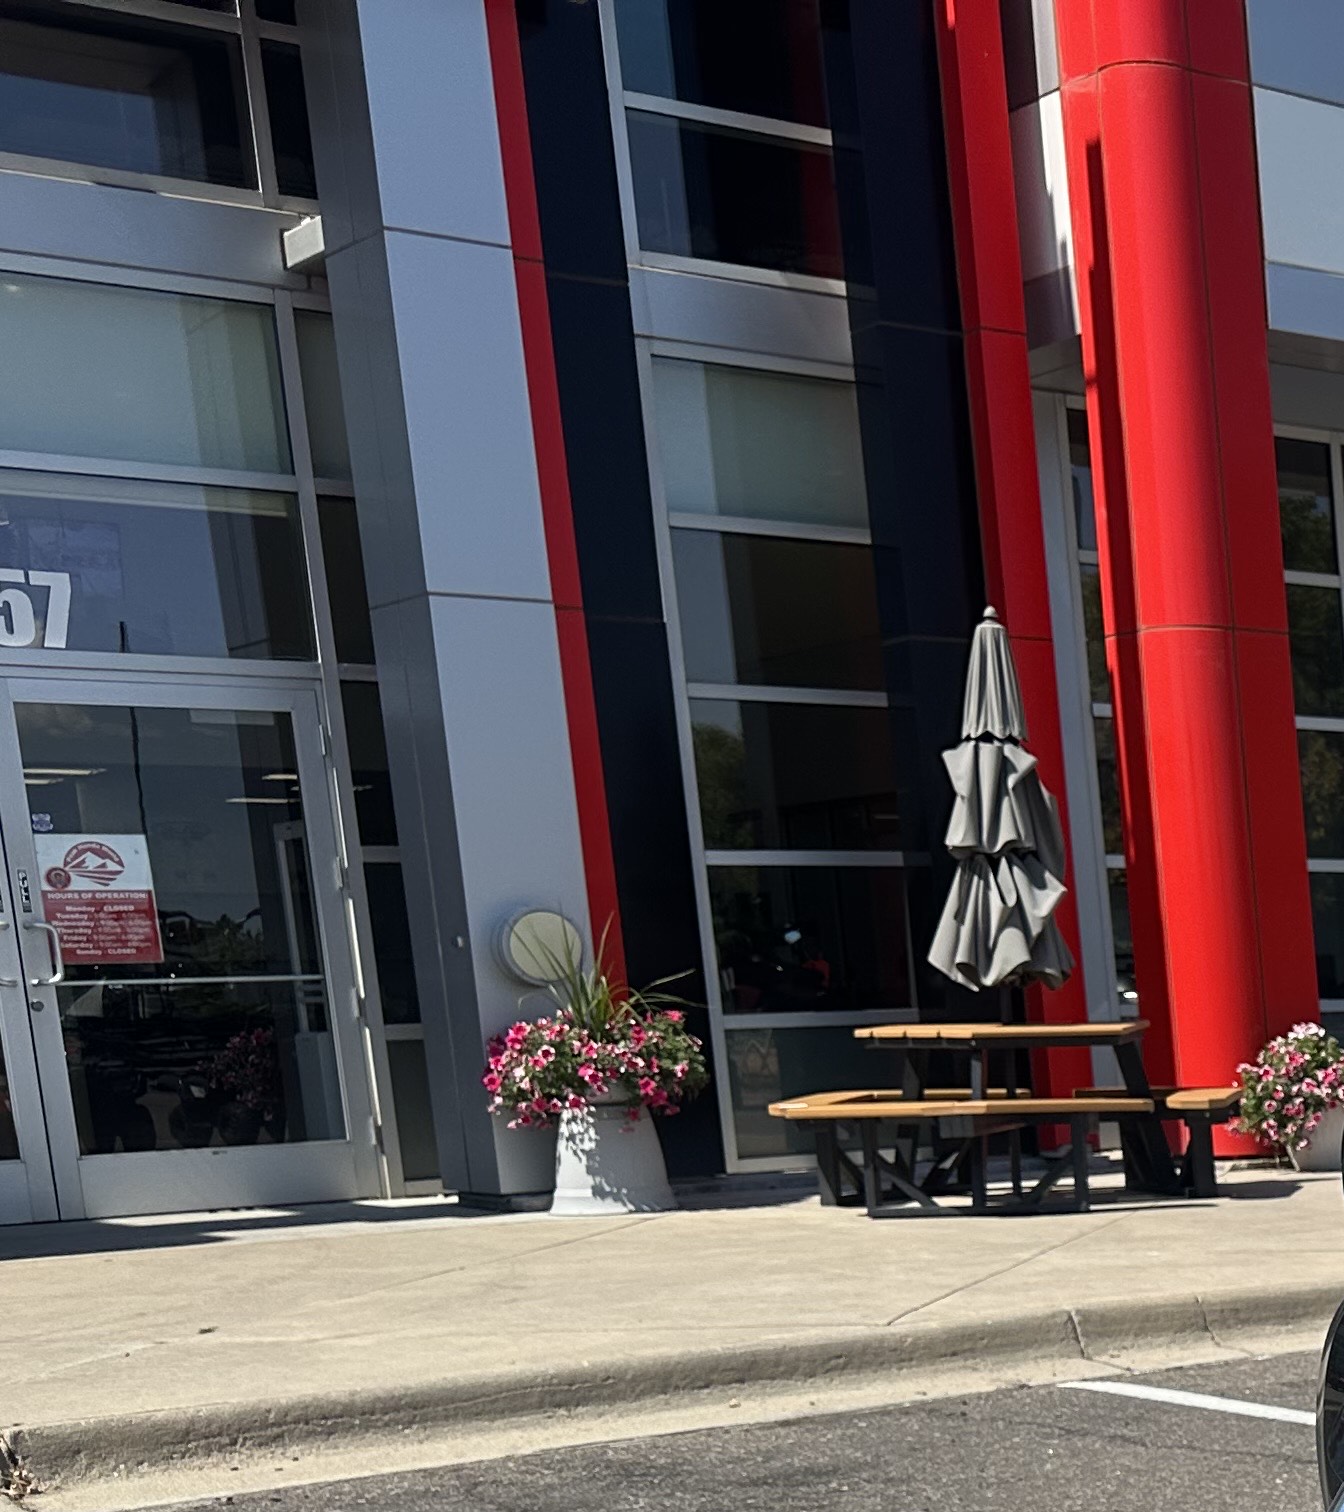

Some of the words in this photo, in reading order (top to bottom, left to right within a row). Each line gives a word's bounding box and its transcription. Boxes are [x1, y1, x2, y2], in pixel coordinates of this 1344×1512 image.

[0, 568, 72, 649] 57
[19, 871, 30, 904] PULL
[47, 892, 79, 900] HOURS
[65, 905, 95, 913] Monday
[103, 904, 135, 912] CLOSED
[56, 912, 88, 920] Tuesday
[57, 927, 92, 935] Thursday
[62, 934, 87, 942] Friday
